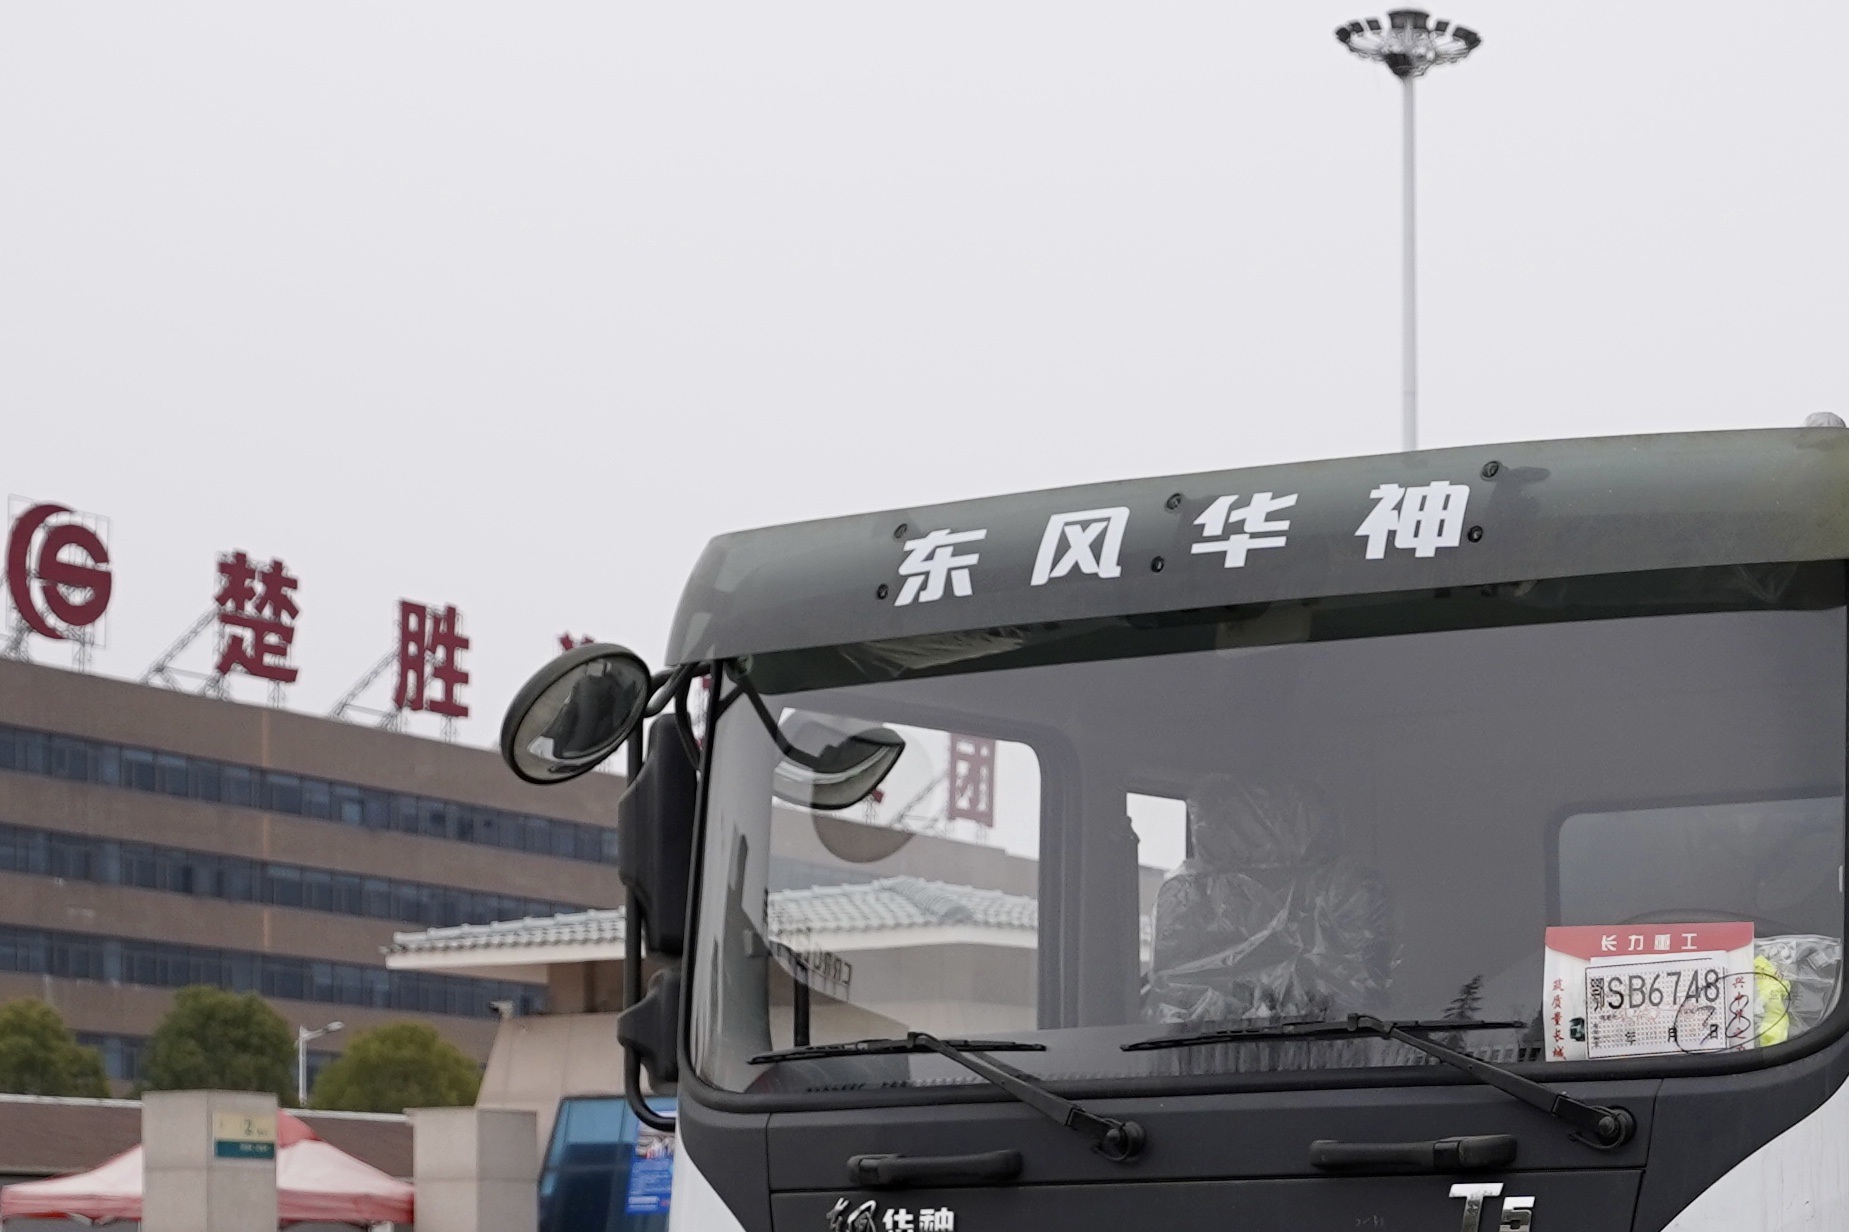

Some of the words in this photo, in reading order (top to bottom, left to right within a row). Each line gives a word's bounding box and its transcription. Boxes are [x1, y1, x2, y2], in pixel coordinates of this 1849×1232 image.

[895, 481, 1471, 606] 东风华神
[1601, 933, 1698, 951] 长力重工
